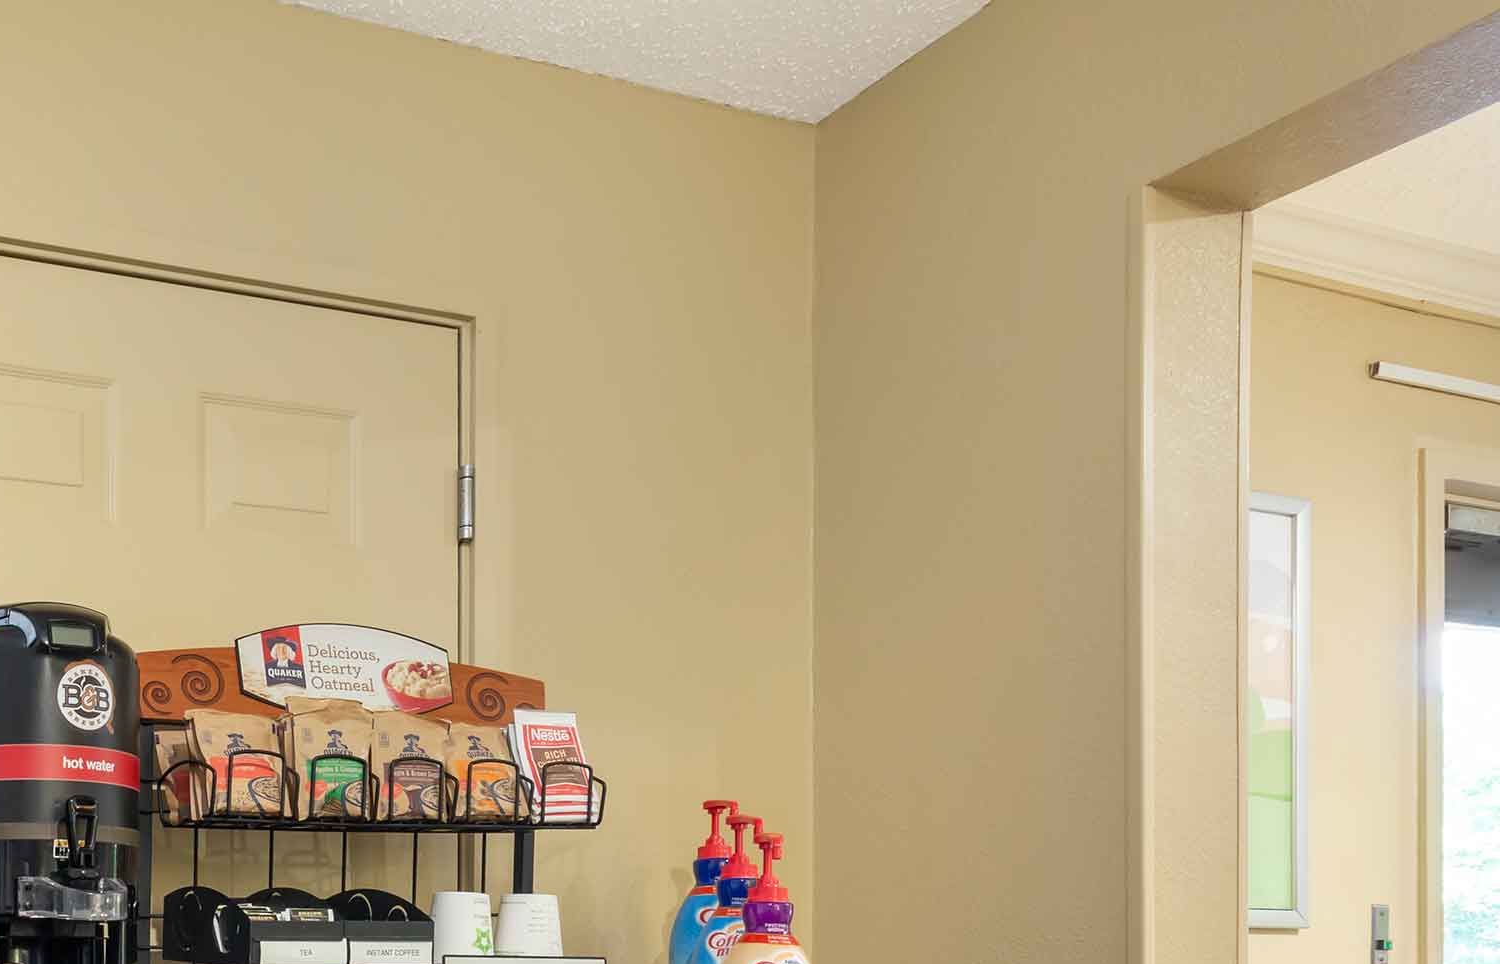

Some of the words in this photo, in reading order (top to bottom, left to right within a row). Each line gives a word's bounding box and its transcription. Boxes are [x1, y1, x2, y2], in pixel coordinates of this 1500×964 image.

[308, 644, 380, 663] Delicious,
[268, 668, 303, 679] QUAKER
[310, 660, 361, 678] Hearty
[312, 676, 374, 692] Oatmeal
[62, 684, 110, 711] B&B
[545, 749, 566, 760] RICH
[62, 756, 85, 769] hot
[86, 760, 115, 772] water
[395, 949, 420, 957] COFFEE
